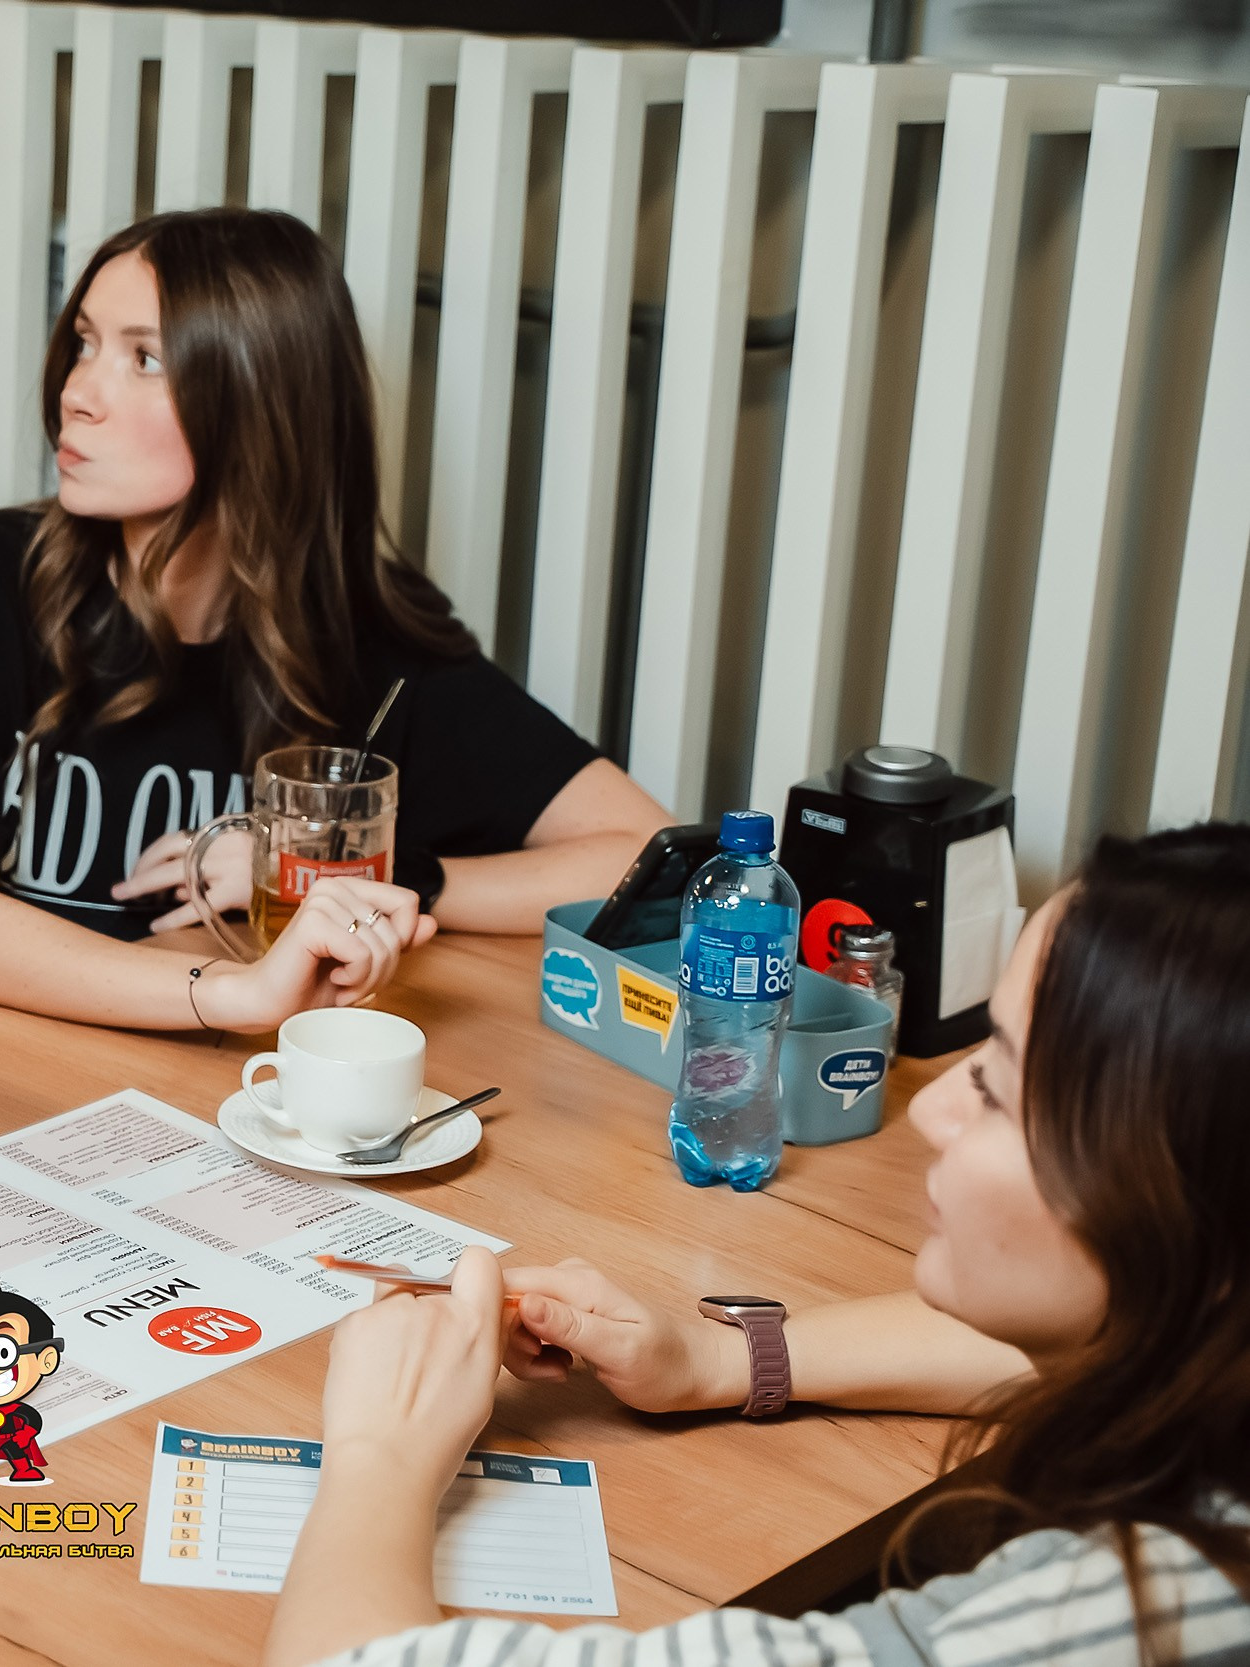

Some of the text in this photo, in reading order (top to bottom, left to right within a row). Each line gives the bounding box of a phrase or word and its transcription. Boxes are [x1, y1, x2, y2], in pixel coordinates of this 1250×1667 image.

[83, 1277, 201, 1328] MENU
[157, 1324, 181, 1338] BAR
[180, 1315, 251, 1352] MF
[201, 1441, 301, 1459] BRAINBOY
[188, 1461, 194, 1471] 1
[186, 1476, 195, 1488] 2
[183, 1494, 193, 1505] 3
[182, 1511, 191, 1522] 4
[181, 1528, 190, 1539] 5
[179, 1546, 188, 1556] 6
